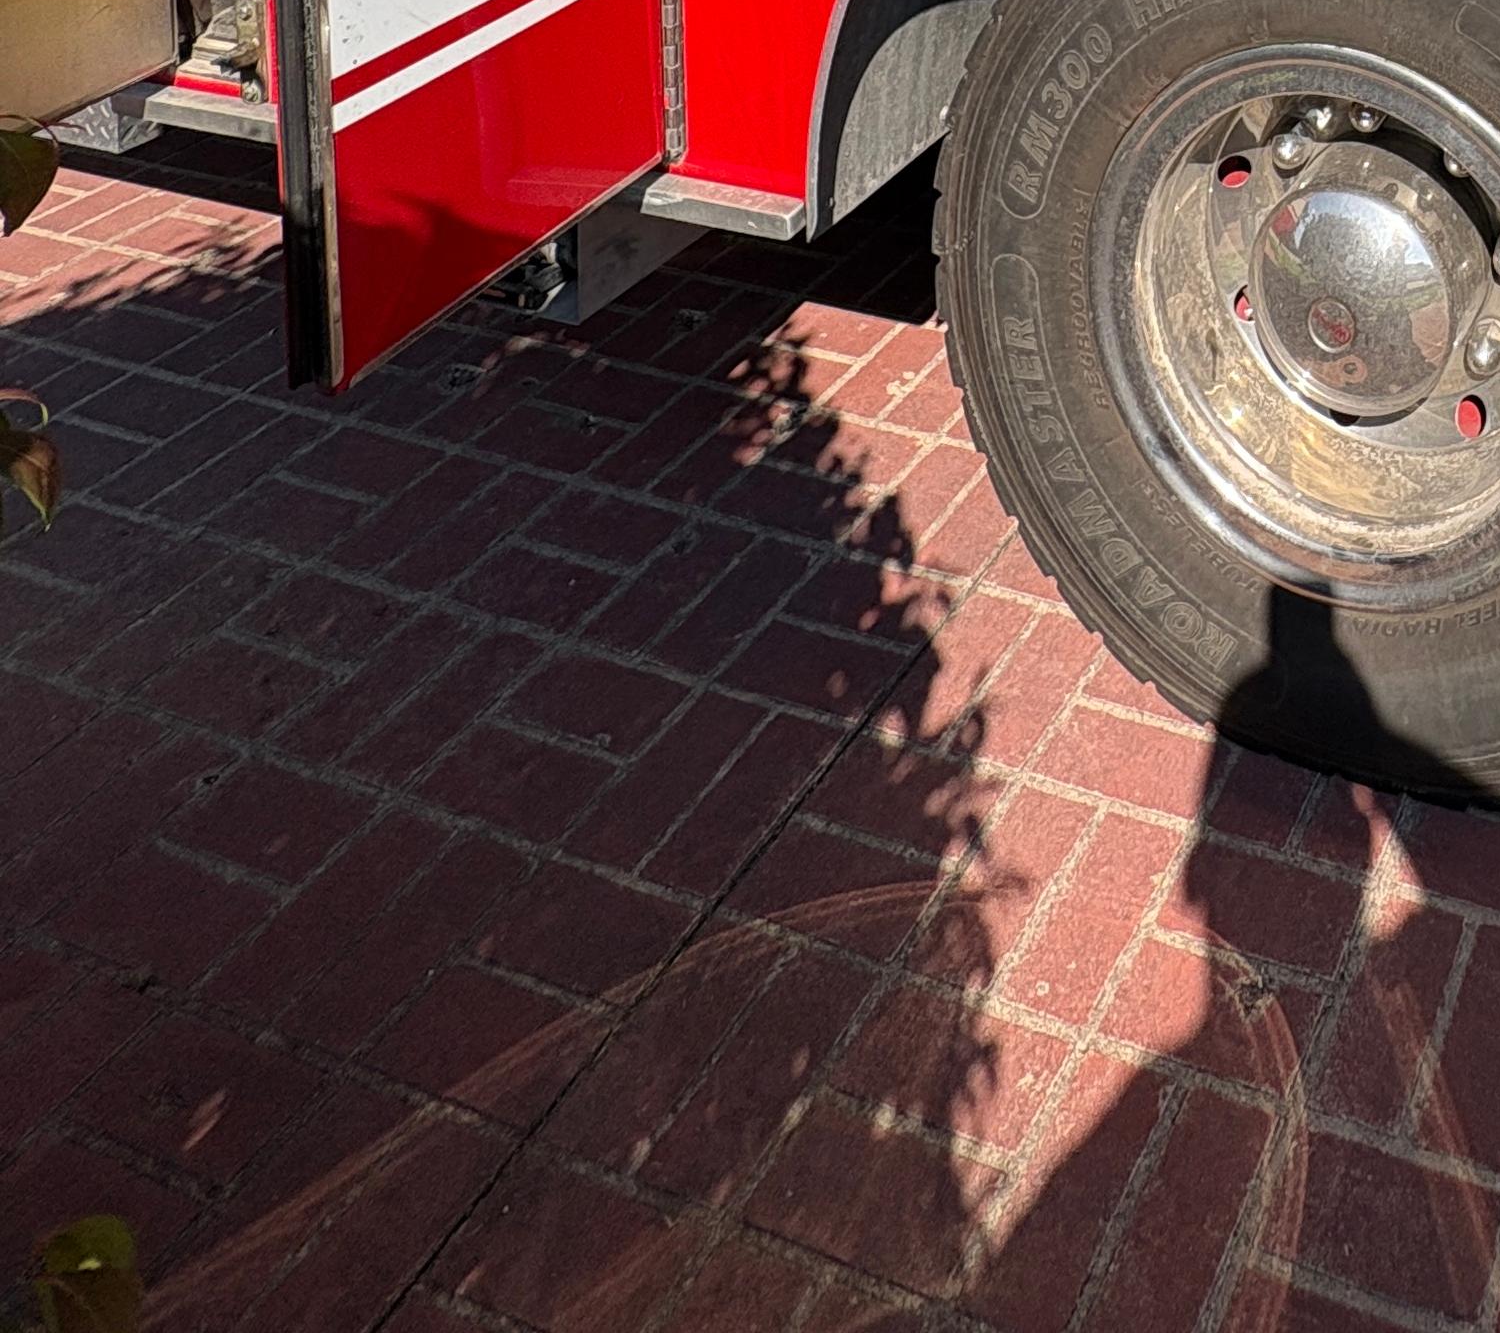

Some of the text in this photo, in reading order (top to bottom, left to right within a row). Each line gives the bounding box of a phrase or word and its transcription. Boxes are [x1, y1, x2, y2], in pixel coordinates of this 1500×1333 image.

[1007, 23, 1113, 205] RM300
[1003, 316, 1239, 672] ROADMASTER
[1341, 616, 1442, 637] RADIA
